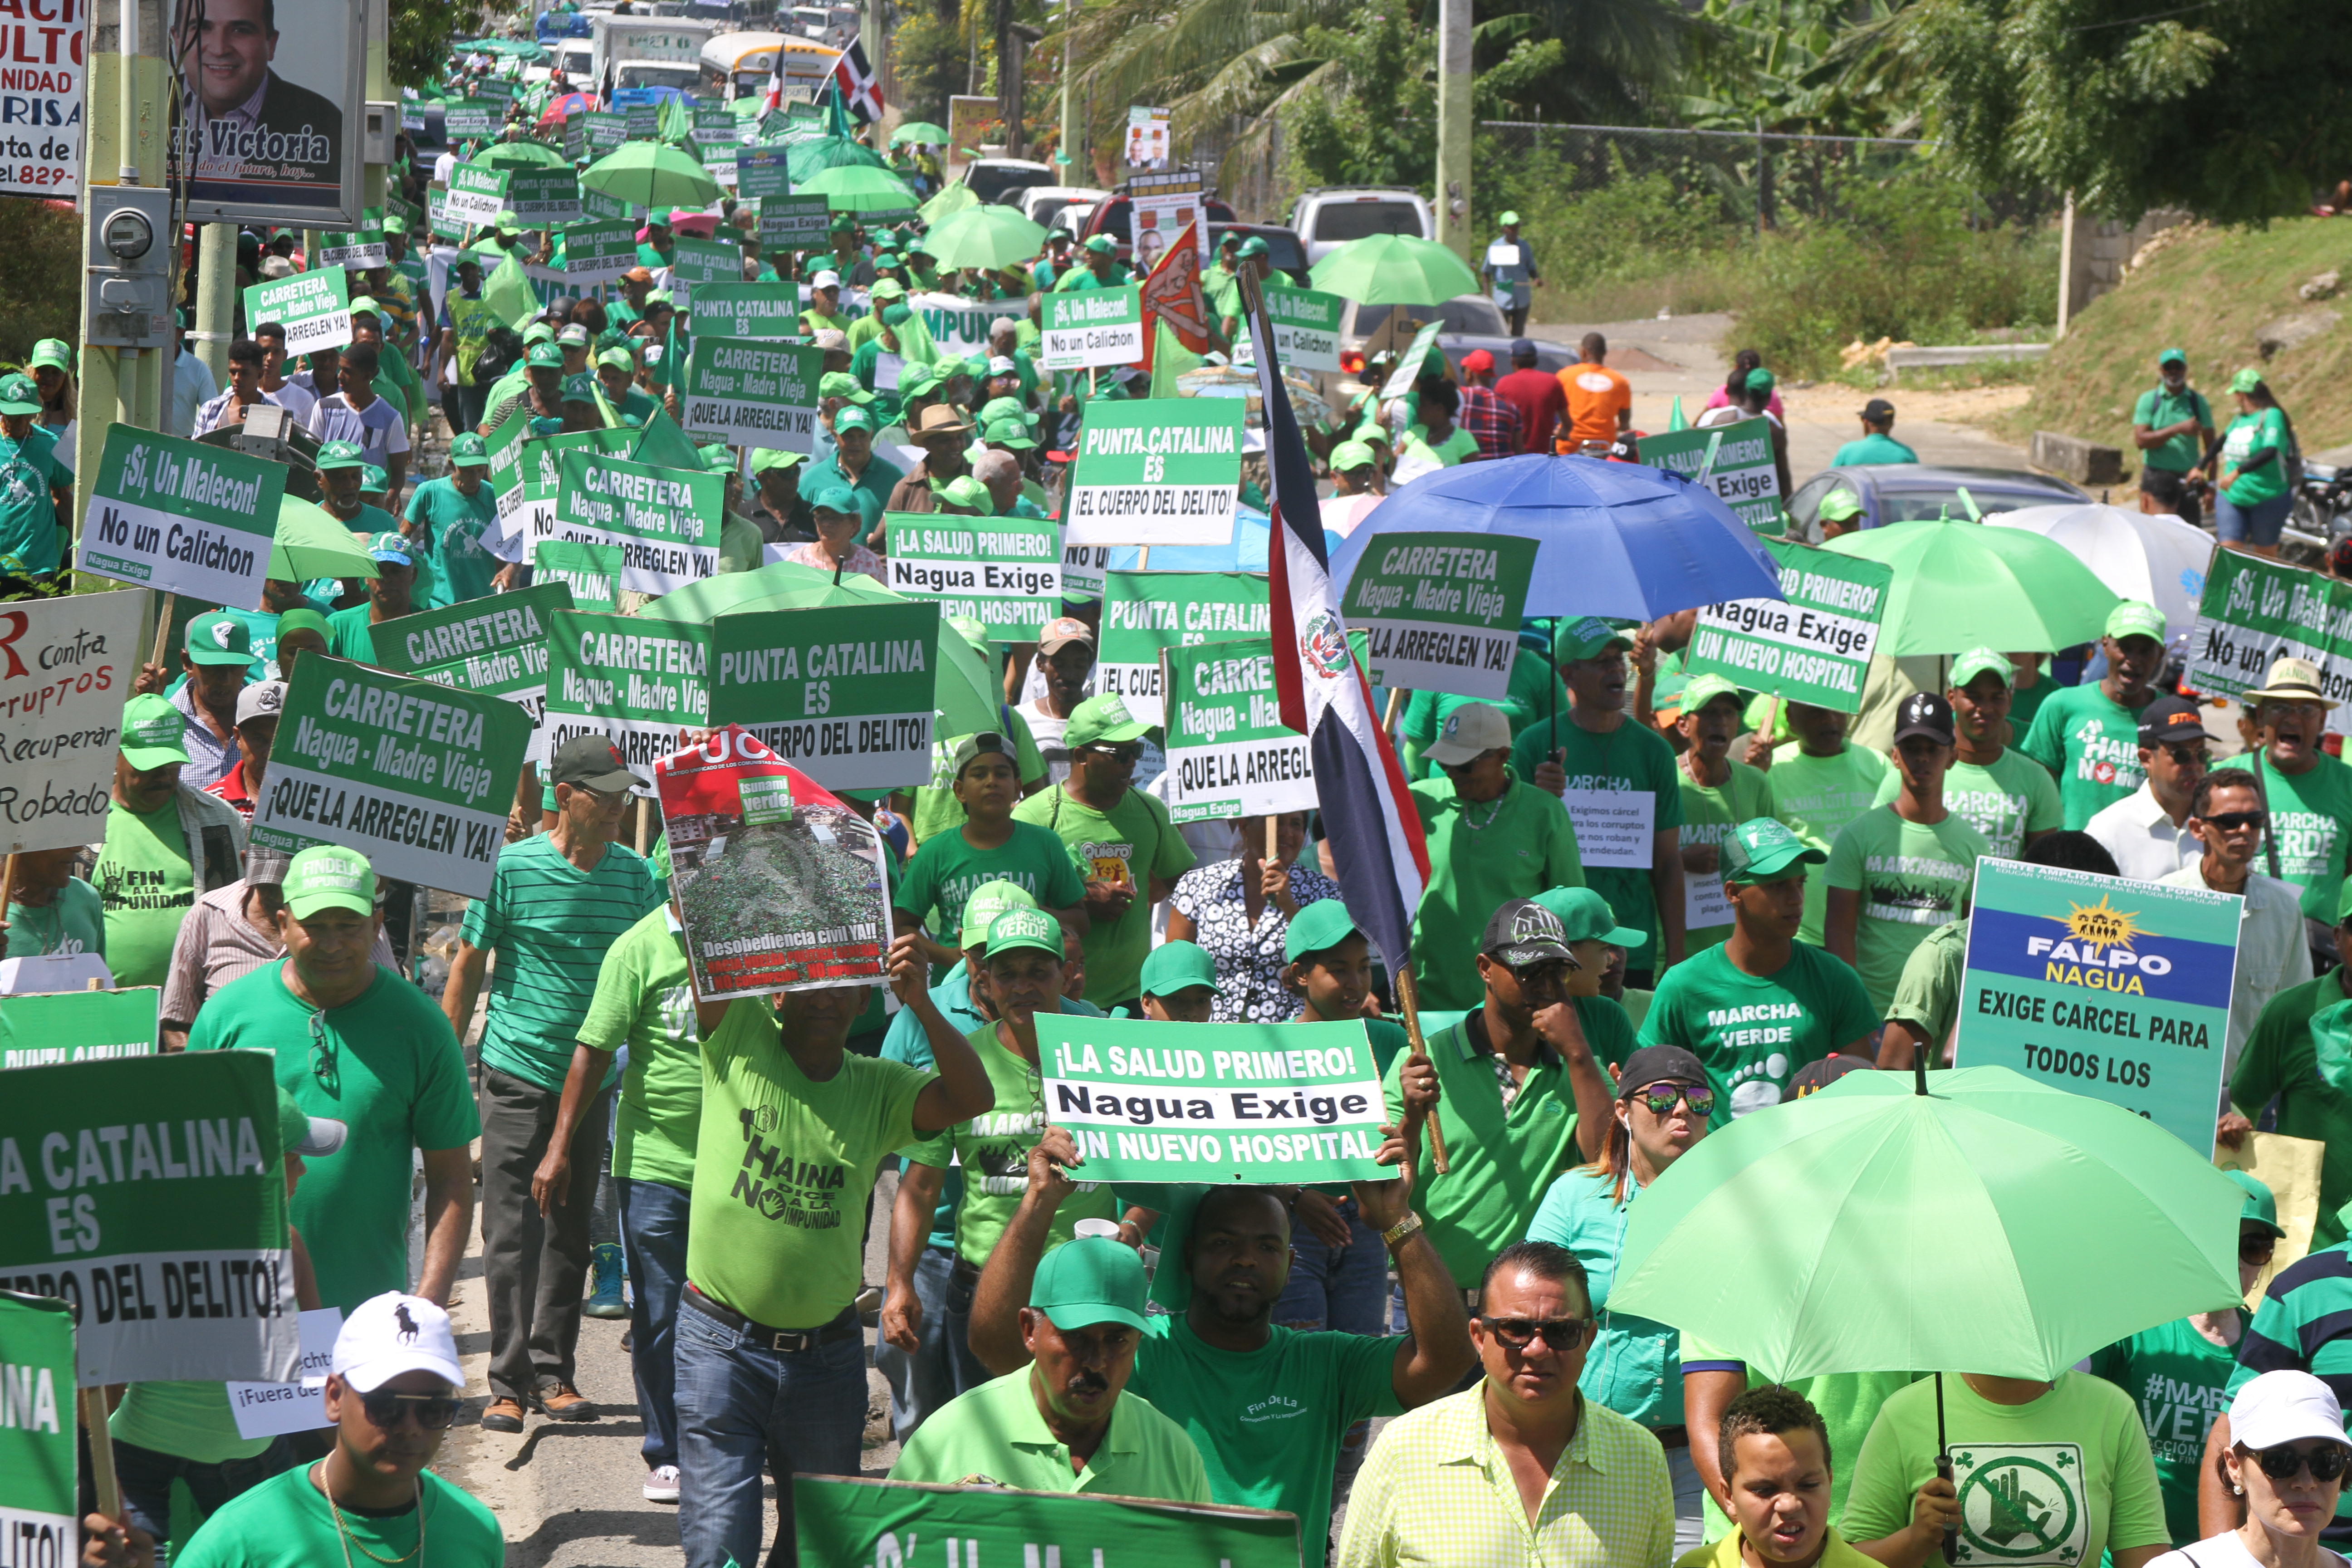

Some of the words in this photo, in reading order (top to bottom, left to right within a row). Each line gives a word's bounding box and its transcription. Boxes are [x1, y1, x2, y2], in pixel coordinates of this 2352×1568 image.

[446, 117, 468, 126] Nagua
[468, 117, 487, 126] Exige
[208, 119, 329, 163] Victoria
[232, 162, 277, 178] futuro,
[450, 192, 460, 206] No
[461, 196, 469, 208] un
[470, 196, 498, 214] Calichon
[568, 235, 593, 247] PUNTA
[594, 230, 633, 245] CATALINA
[763, 219, 795, 231] Nagua
[798, 217, 826, 230] Exige
[260, 276, 328, 307] CARRETERA
[287, 298, 314, 318] Madre
[316, 293, 338, 313] Vieja
[694, 300, 734, 317] PUNTA
[736, 300, 795, 317] CATALINA
[1071, 298, 1086, 324] Un
[1087, 294, 1128, 321] Malecon!
[335, 316, 348, 331] YA!
[735, 318, 750, 335] ES
[1051, 334, 1068, 353] No
[1070, 335, 1084, 351] un
[1087, 324, 1134, 350] Calichon
[714, 346, 799, 375] CARRETERA
[700, 368, 734, 396] Nagua
[743, 373, 775, 397] Madre
[779, 377, 807, 404] Vieja
[733, 406, 792, 432] ARREGLEN
[795, 412, 813, 434] YA!
[1086, 427, 1143, 456] PUNTA
[1148, 426, 1235, 456] CATALINA
[154, 451, 177, 496] Un
[180, 457, 263, 515] Malecon!
[1142, 456, 1165, 483] ES
[584, 466, 693, 509] CARRETERA
[1717, 473, 1772, 500] Exige
[569, 490, 612, 530] Nagua
[623, 500, 666, 533] Madre
[670, 508, 704, 543] Vieja
[1097, 490, 1150, 516] CUERPO
[1152, 490, 1177, 516] DEL
[1181, 489, 1232, 516] DELITO!
[98, 506, 129, 546] No
[133, 523, 160, 554] un
[167, 523, 255, 577] Calichon
[923, 529, 974, 555] SALUD
[978, 533, 1052, 557] PRIMERO!
[88, 552, 120, 570] Nagua
[121, 561, 149, 578] Exige
[692, 553, 715, 578] YA!
[1381, 546, 1498, 581] CARRETERA
[895, 563, 975, 591] Nagua
[985, 566, 1055, 594] Exige
[1356, 578, 1404, 615] Nagua
[1412, 579, 1460, 614] Madre
[1465, 583, 1505, 625] Vieja
[1800, 573, 1880, 614] PRIMERO!
[1109, 600, 1178, 631] PUNTA
[406, 604, 544, 666] CARRETERA
[1797, 613, 1867, 655] Exige
[2205, 628, 2234, 664] No
[719, 646, 799, 686] PUNTA
[806, 638, 926, 679] CATALINA
[1392, 629, 1481, 667] ARREGLEN
[1483, 638, 1511, 671] YA!
[1697, 630, 1722, 660] UN
[1723, 639, 1781, 674] NUEVO
[1780, 651, 1857, 694] HOSPITAL
[465, 654, 521, 689] Madre
[562, 667, 614, 713] Nagua
[627, 673, 678, 711] Madre
[803, 681, 831, 715] ES
[133, 718, 163, 729] CÁRCEL
[323, 678, 485, 752] CARRETERA
[1181, 701, 1236, 743] Nagua
[820, 721, 852, 756] DEL
[858, 717, 926, 753] DELITO!
[293, 715, 360, 770] Nagua
[372, 734, 435, 785] Madre
[441, 751, 493, 805] Vieja
[740, 779, 787, 794] tsunami
[1173, 807, 1207, 821] Nagua
[1209, 802, 1240, 818] Exige
[1570, 805, 1610, 816] Exigimos
[1612, 806, 1639, 816] cárcel
[346, 790, 462, 855] ARREGLEN
[465, 820, 498, 863] YA!
[1587, 820, 1599, 828] los
[1601, 822, 1645, 831] corruptos
[1606, 834, 1632, 842] roban
[1082, 841, 1133, 860] Quiero
[127, 869, 165, 886] FIN
[145, 886, 159, 894] LA
[301, 875, 362, 892] IMPUNIDAD
[1984, 859, 2034, 872] FRENTE
[2038, 868, 2089, 881] AMPLIO
[2093, 876, 2111, 884] DE
[2115, 879, 2161, 892] LUCHA
[2166, 888, 2231, 902] POPULAR
[1996, 868, 2034, 878] EDUCAR
[2043, 874, 2097, 888] ORGANIZAR
[2140, 890, 2173, 899] PODER
[2176, 895, 2220, 906] POPULAR
[973, 896, 1005, 911] CÁRCEL
[1695, 891, 1721, 901] contra
[1701, 904, 1724, 915] plaga
[996, 921, 1048, 942] VERDE
[997, 911, 1048, 929] #MARCHA
[703, 929, 816, 958] Desobediencia
[818, 926, 848, 944] civil
[849, 922, 877, 941] YA!!
[744, 953, 786, 970] HUELGA
[836, 943, 881, 959] GENERAL
[2027, 935, 2172, 976] FALPO
[2045, 961, 2146, 996] NAGUA
[1707, 1002, 1803, 1028] MARCHA
[1978, 988, 2046, 1023] EXIGE
[2052, 1000, 2141, 1039] CARCEL
[2149, 1015, 2209, 1049] PARA
[1719, 1026, 1792, 1049] VERDE
[1054, 1042, 1103, 1078] ¡LA
[1107, 1046, 1205, 1080] SALUD
[1211, 1046, 1356, 1081] PRIMERO!
[2024, 1044, 2100, 1079] TODOS
[2107, 1057, 2151, 1088] LOS
[1057, 1084, 1215, 1126] Nagua
[1230, 1091, 1369, 1125] Exige
[41, 1117, 267, 1191] CATALINA
[1117, 1131, 1222, 1163] NUEVO
[1229, 1129, 1377, 1164] HOSPITAL
[742, 1135, 845, 1190] HAINA
[777, 1182, 837, 1200] DICE
[809, 1200, 833, 1210] LA
[46, 1193, 101, 1255] ES
[784, 1206, 841, 1230] IMPUNIDAD
[93, 1262, 157, 1325] DEL
[161, 1258, 282, 1320] DELITO!
[237, 1385, 294, 1408] ¡Fuera
[1247, 1400, 1266, 1415] Fin
[1268, 1394, 1282, 1405] De
[1283, 1396, 1298, 1407] La
[1240, 1414, 1270, 1423] Corrupción
[2179, 1455, 2196, 1465] FIN
